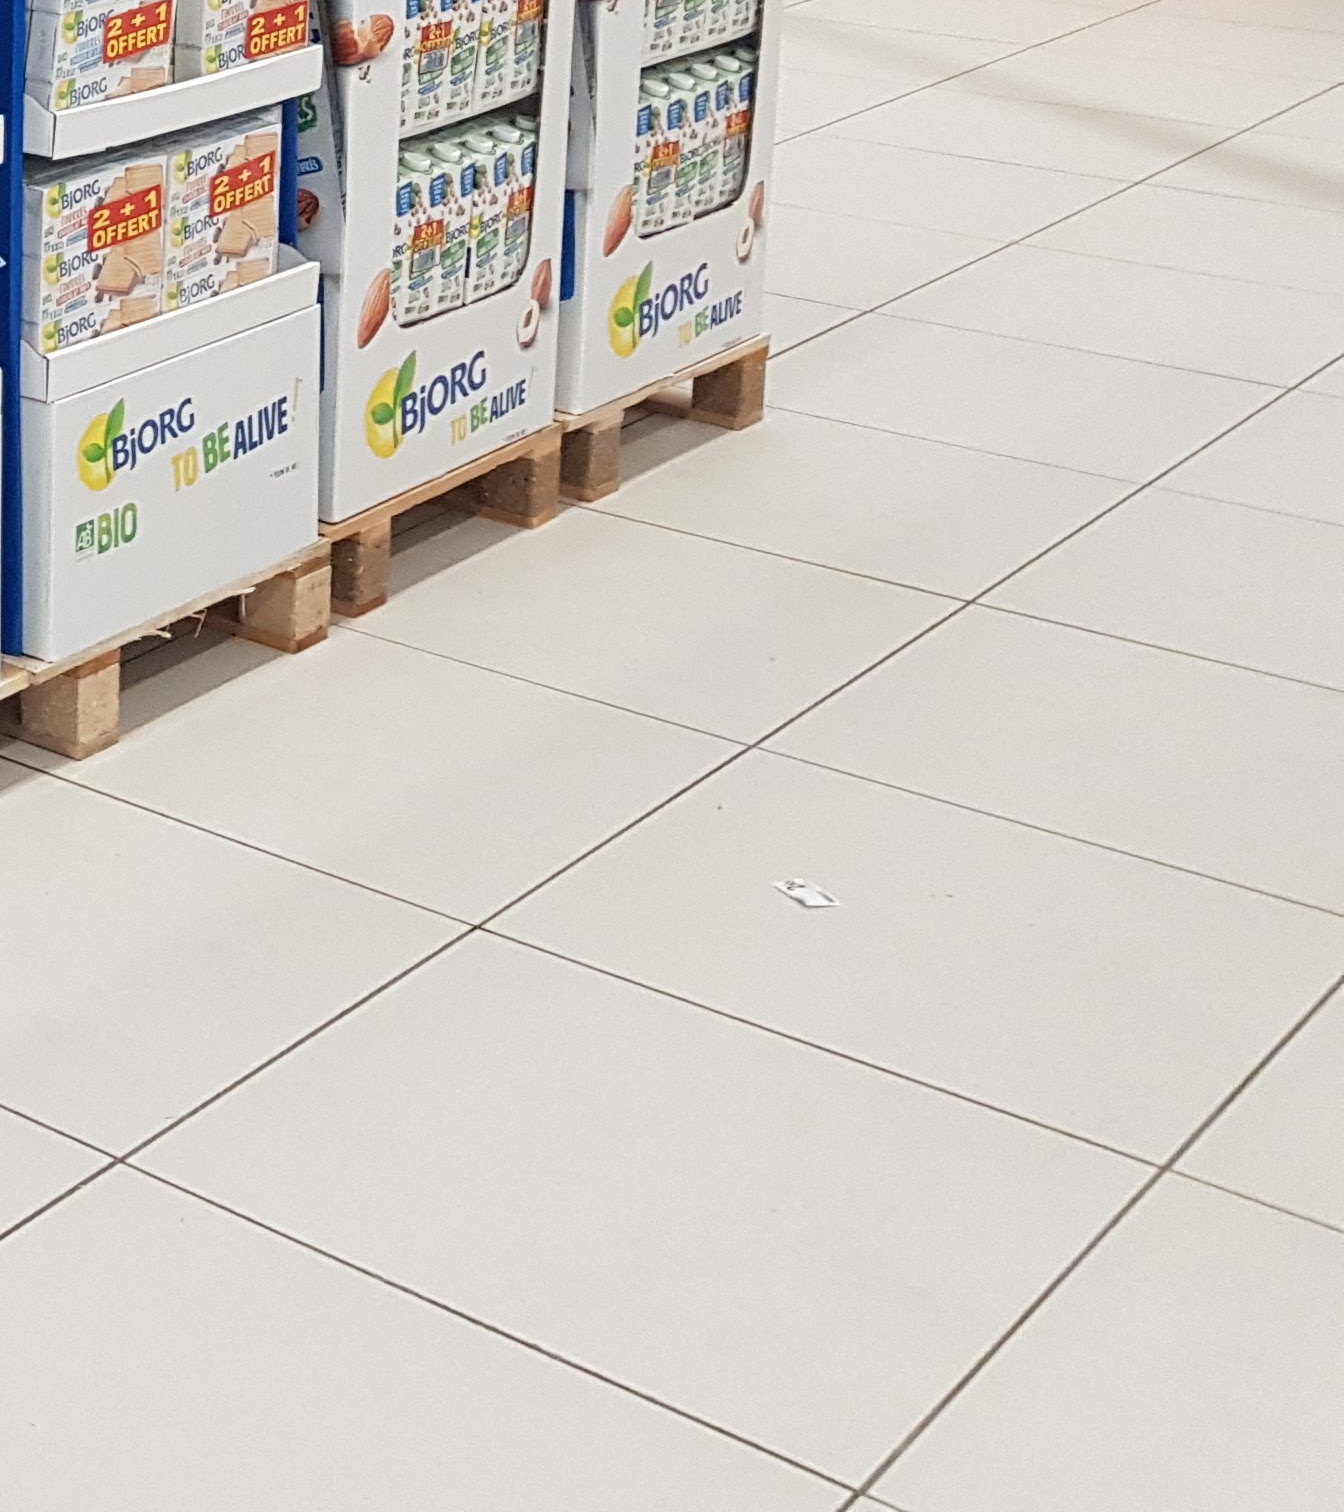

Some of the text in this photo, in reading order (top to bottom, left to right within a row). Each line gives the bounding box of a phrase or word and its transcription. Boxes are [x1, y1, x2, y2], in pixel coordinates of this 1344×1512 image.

[106, 22, 169, 60] OFFERT
[248, 23, 307, 59] OFFERT
[212, 174, 273, 216] OFFERT
[91, 209, 160, 249] OFFERT
[710, 290, 743, 329] ALIVE
[470, 396, 488, 434] BE
[490, 377, 527, 423] ALIVE
[172, 396, 288, 492] TO BE ALIVE
[97, 502, 138, 555] BIO
